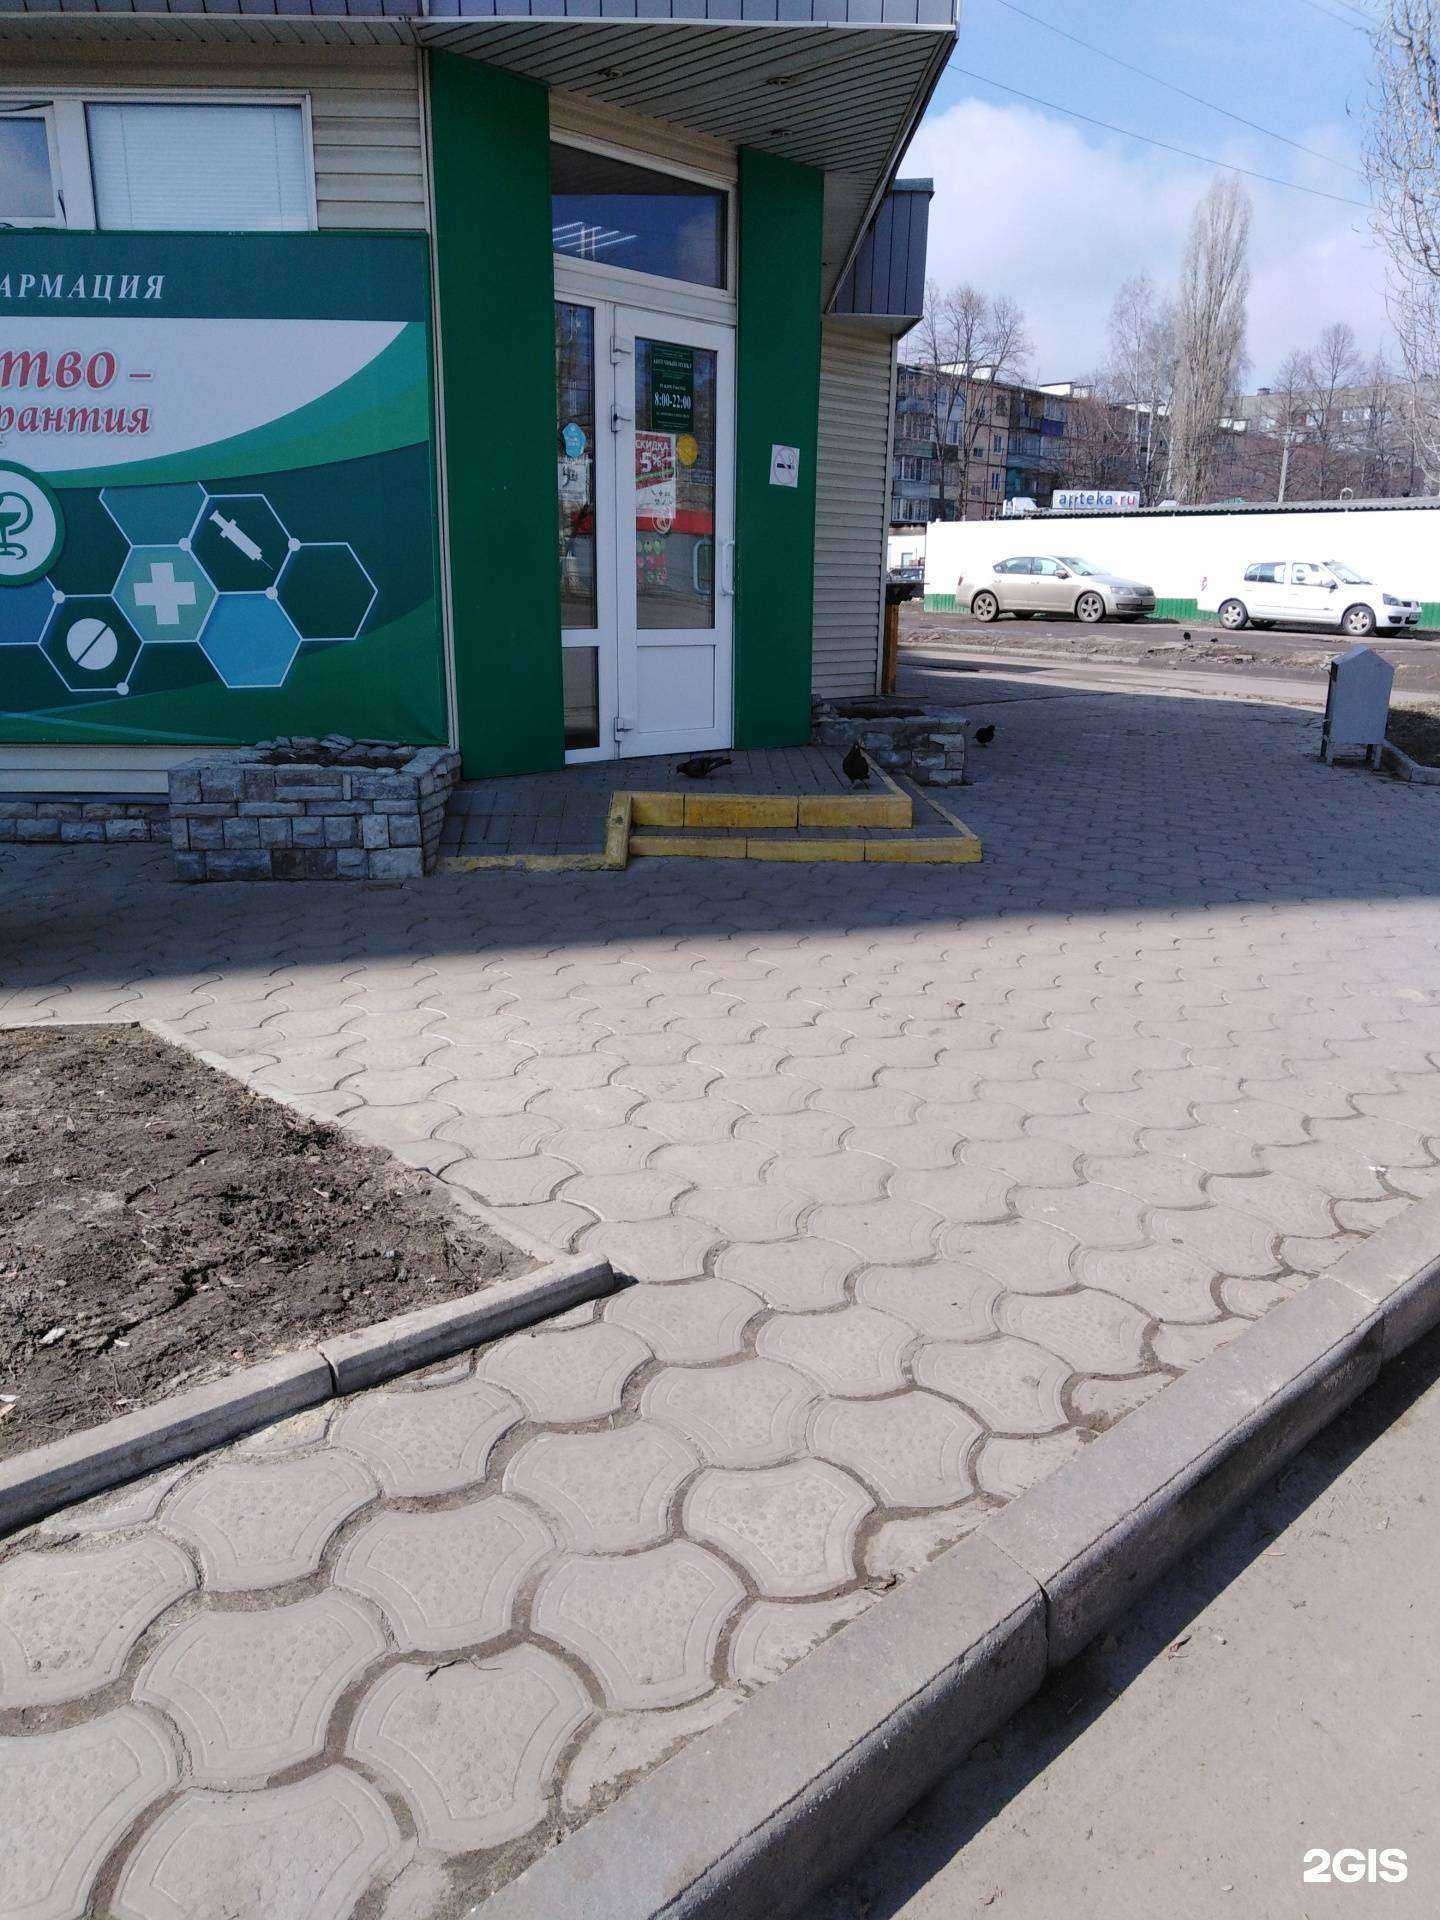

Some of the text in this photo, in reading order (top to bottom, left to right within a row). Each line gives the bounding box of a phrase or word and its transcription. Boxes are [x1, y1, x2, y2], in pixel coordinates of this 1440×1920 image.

[0, 273, 165, 304] АРМАЦИЯ
[0, 351, 116, 388] тво
[654, 392, 692, 410] 8:00-22:00
[635, 439, 669, 451] СКИДКА
[640, 451, 663, 473] 5%
